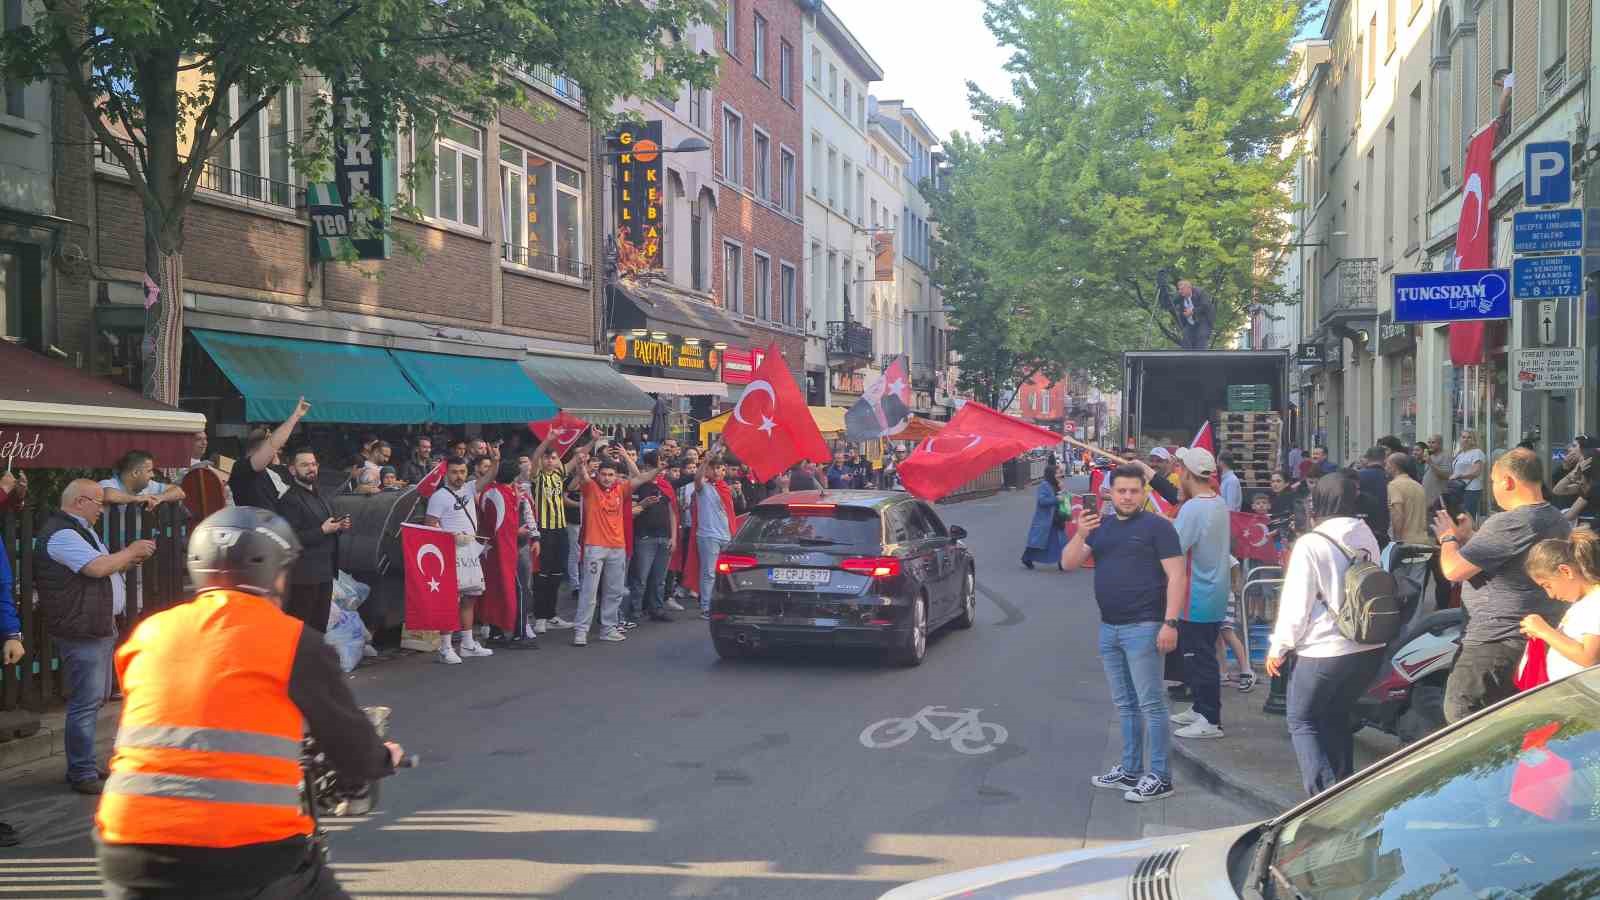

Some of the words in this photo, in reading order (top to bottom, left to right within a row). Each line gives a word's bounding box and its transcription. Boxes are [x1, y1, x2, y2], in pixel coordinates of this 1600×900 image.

[1530, 152, 1564, 196] P
[647, 169, 657, 257] KEBAP
[1397, 284, 1486, 301] TUNGSRAM
[1533, 286, 1541, 297] 8
[1558, 285, 1571, 296] 17
[1449, 296, 1478, 310] Light
[0, 430, 44, 459] ebab
